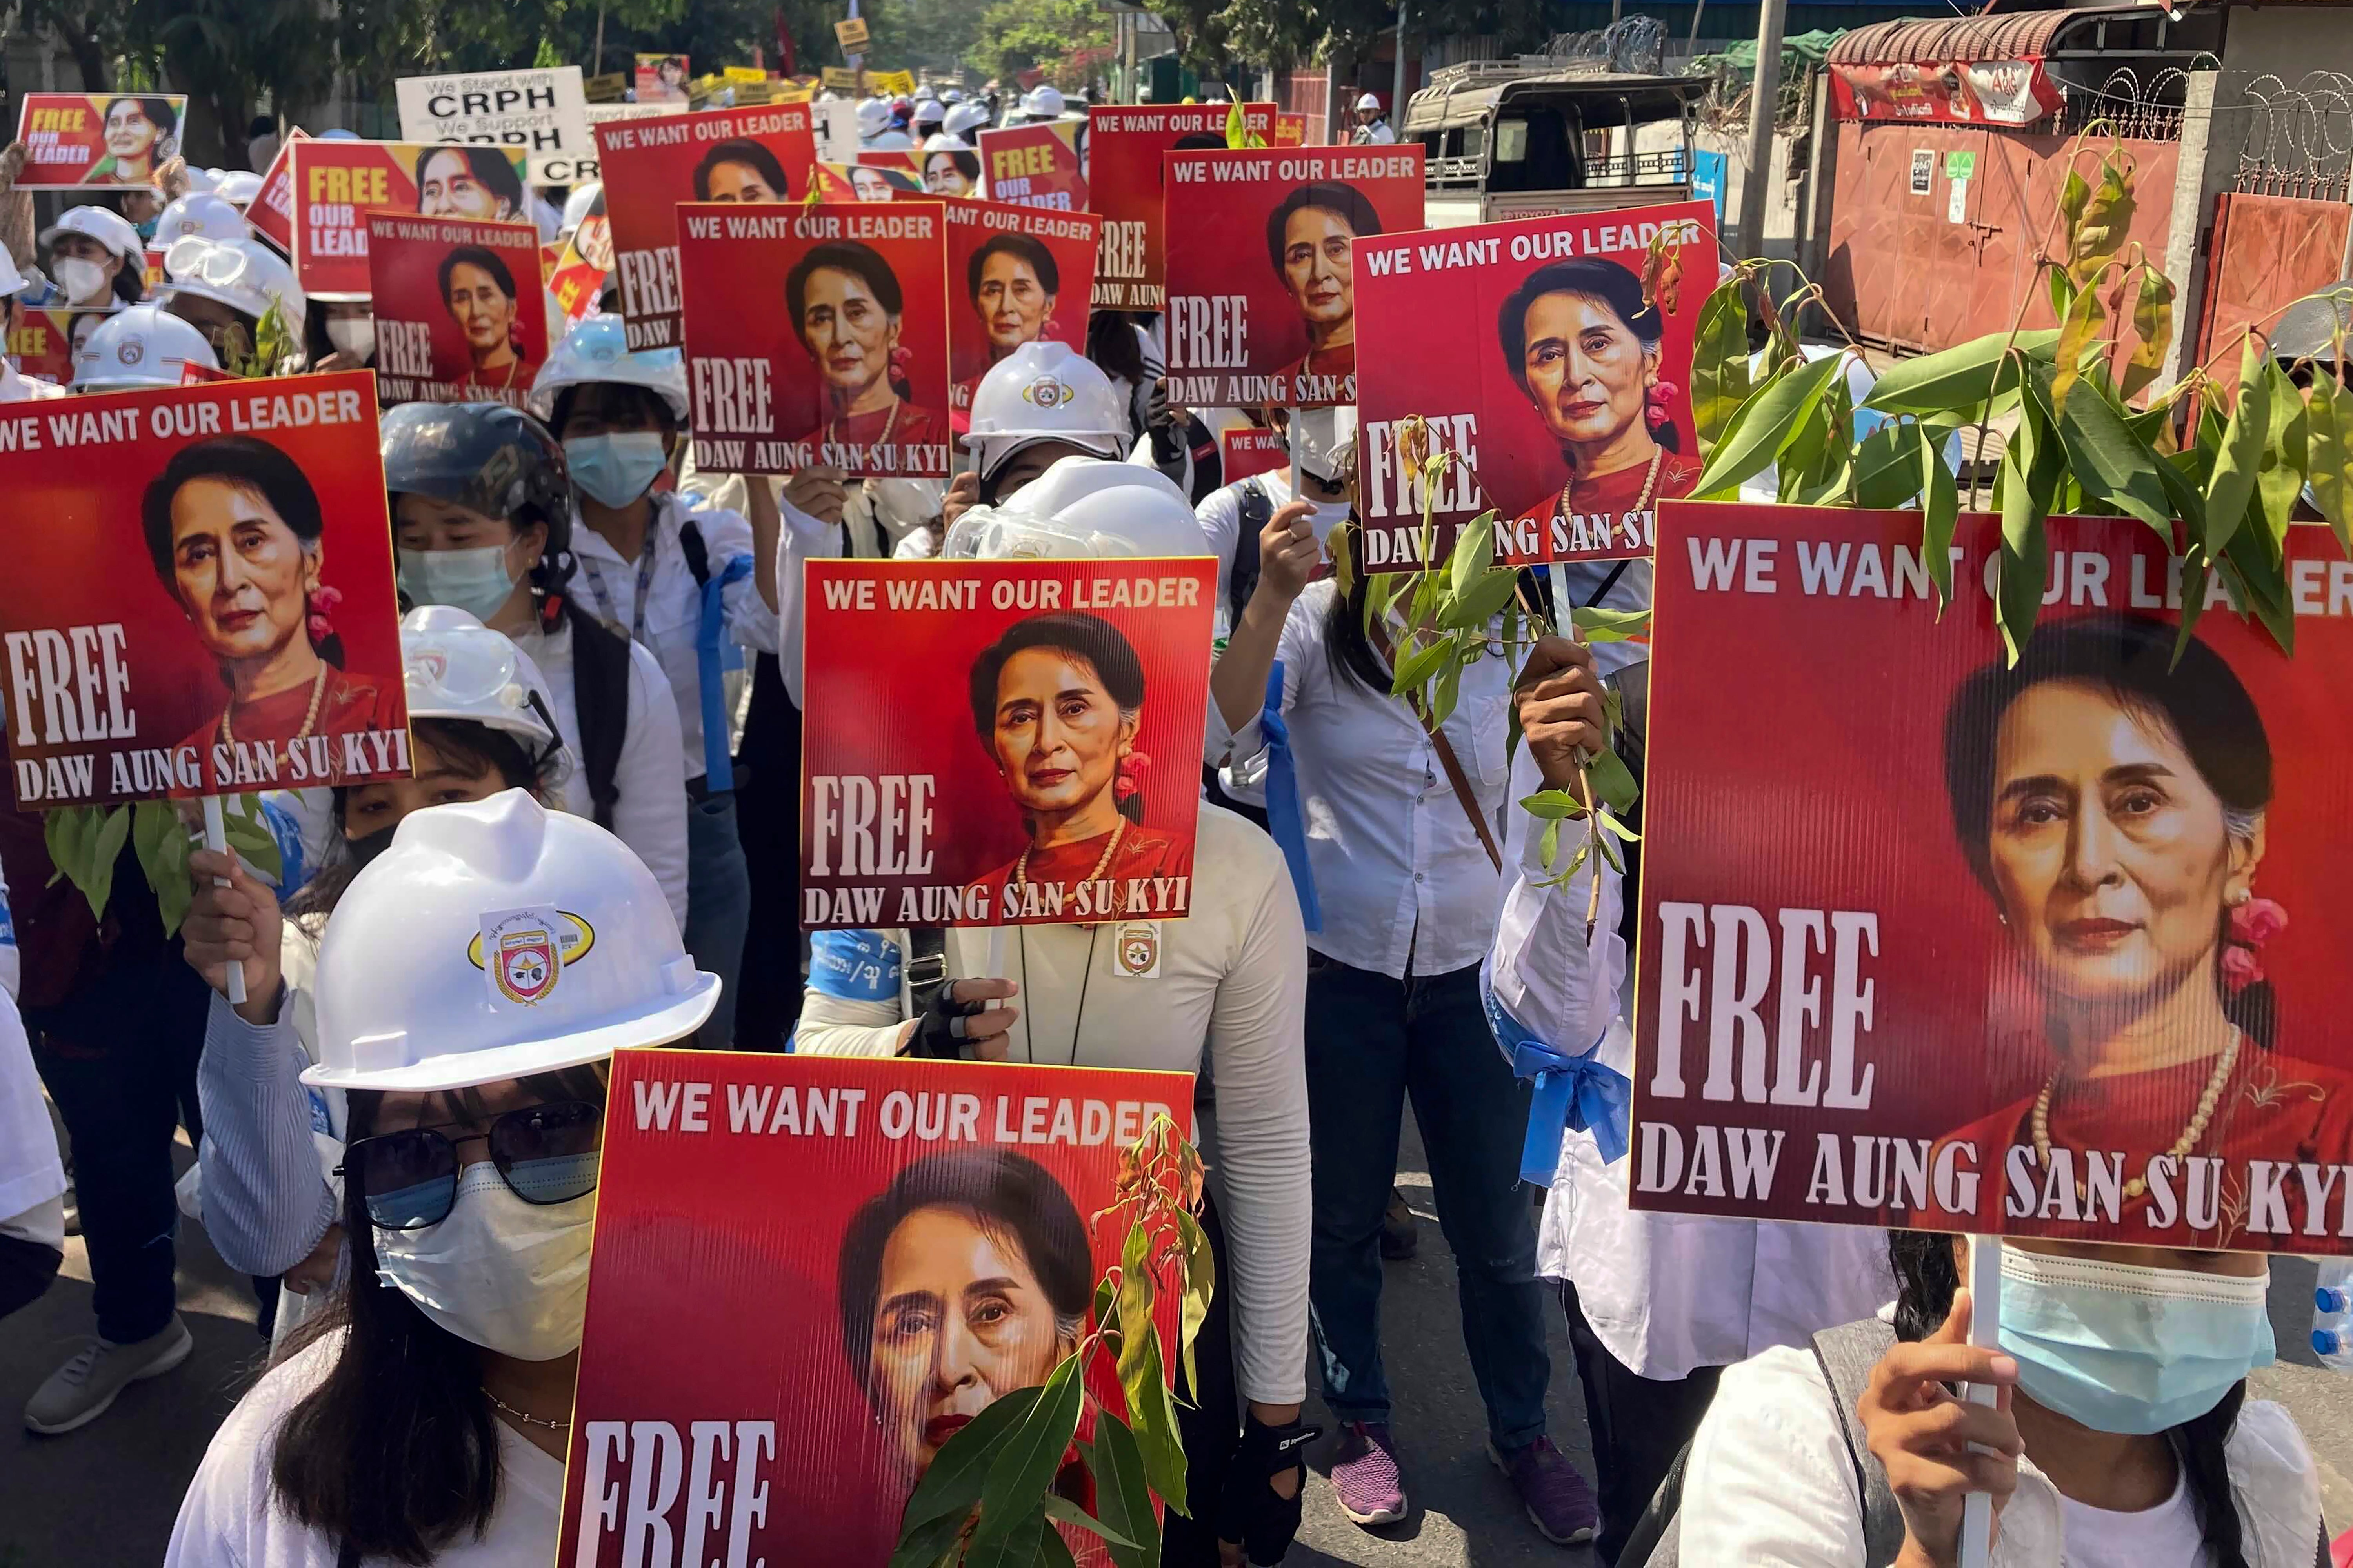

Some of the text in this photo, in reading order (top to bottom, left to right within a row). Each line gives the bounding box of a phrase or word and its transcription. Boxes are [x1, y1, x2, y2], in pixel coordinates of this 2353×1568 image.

[427, 86, 555, 117] CRPH
[27, 130, 58, 145] OUR
[32, 108, 86, 132] FREE
[436, 114, 553, 135] We Support
[604, 112, 805, 151] WE WANT OUR LEADER
[1096, 113, 1269, 132] WE WANT OUR LEER
[28, 145, 90, 164] EADER
[544, 160, 599, 181] CR
[992, 145, 1055, 180] FREE
[1174, 157, 1415, 182] WE WANT OUR LEADER
[309, 167, 389, 203] FREE
[995, 177, 1031, 199] OUR
[310, 204, 355, 227] OUR
[687, 217, 932, 239] WE WANT OUR LEADER
[946, 206, 1092, 241] ANT OUR LEADER
[372, 220, 533, 249] WE WANT OUR LEADER
[1367, 218, 1700, 276] WE WANT OUR LEADER
[618, 246, 683, 317] FRE
[1091, 284, 1124, 306] DAW
[376, 320, 434, 377] FREE
[627, 320, 672, 349] DAW
[1169, 295, 1249, 368] FREE
[379, 377, 414, 400] DAW
[692, 358, 774, 433] FREE
[1167, 376, 1218, 403] DAW
[1227, 376, 1286, 403] AUNG
[1295, 376, 1337, 402] SAN
[0, 389, 362, 453] WE WANT OUR LEADER
[695, 441, 948, 472] DAW AUNG SAN SU KYI
[1231, 436, 1251, 450] WE
[1367, 524, 1438, 565] DAW
[1552, 512, 1613, 553] SAN
[1686, 537, 1778, 593] WE
[823, 577, 1200, 610] WE WANT OUR LEADER
[5, 623, 136, 747] FREE
[16, 728, 410, 802] DAW AUNG SAN SU KYI
[809, 775, 936, 877] FREE
[804, 876, 1189, 924] DAW AUNG SAN SU KYI
[1649, 902, 1879, 1110] FREE
[632, 1081, 1173, 1148] WE WANT OUR LEADER
[1637, 1122, 1785, 1202] DAW
[1806, 1133, 1980, 1216] AUNG
[2005, 1145, 2125, 1224] SAN
[2147, 1154, 2224, 1230] SU
[575, 1420, 776, 1568] FREE
